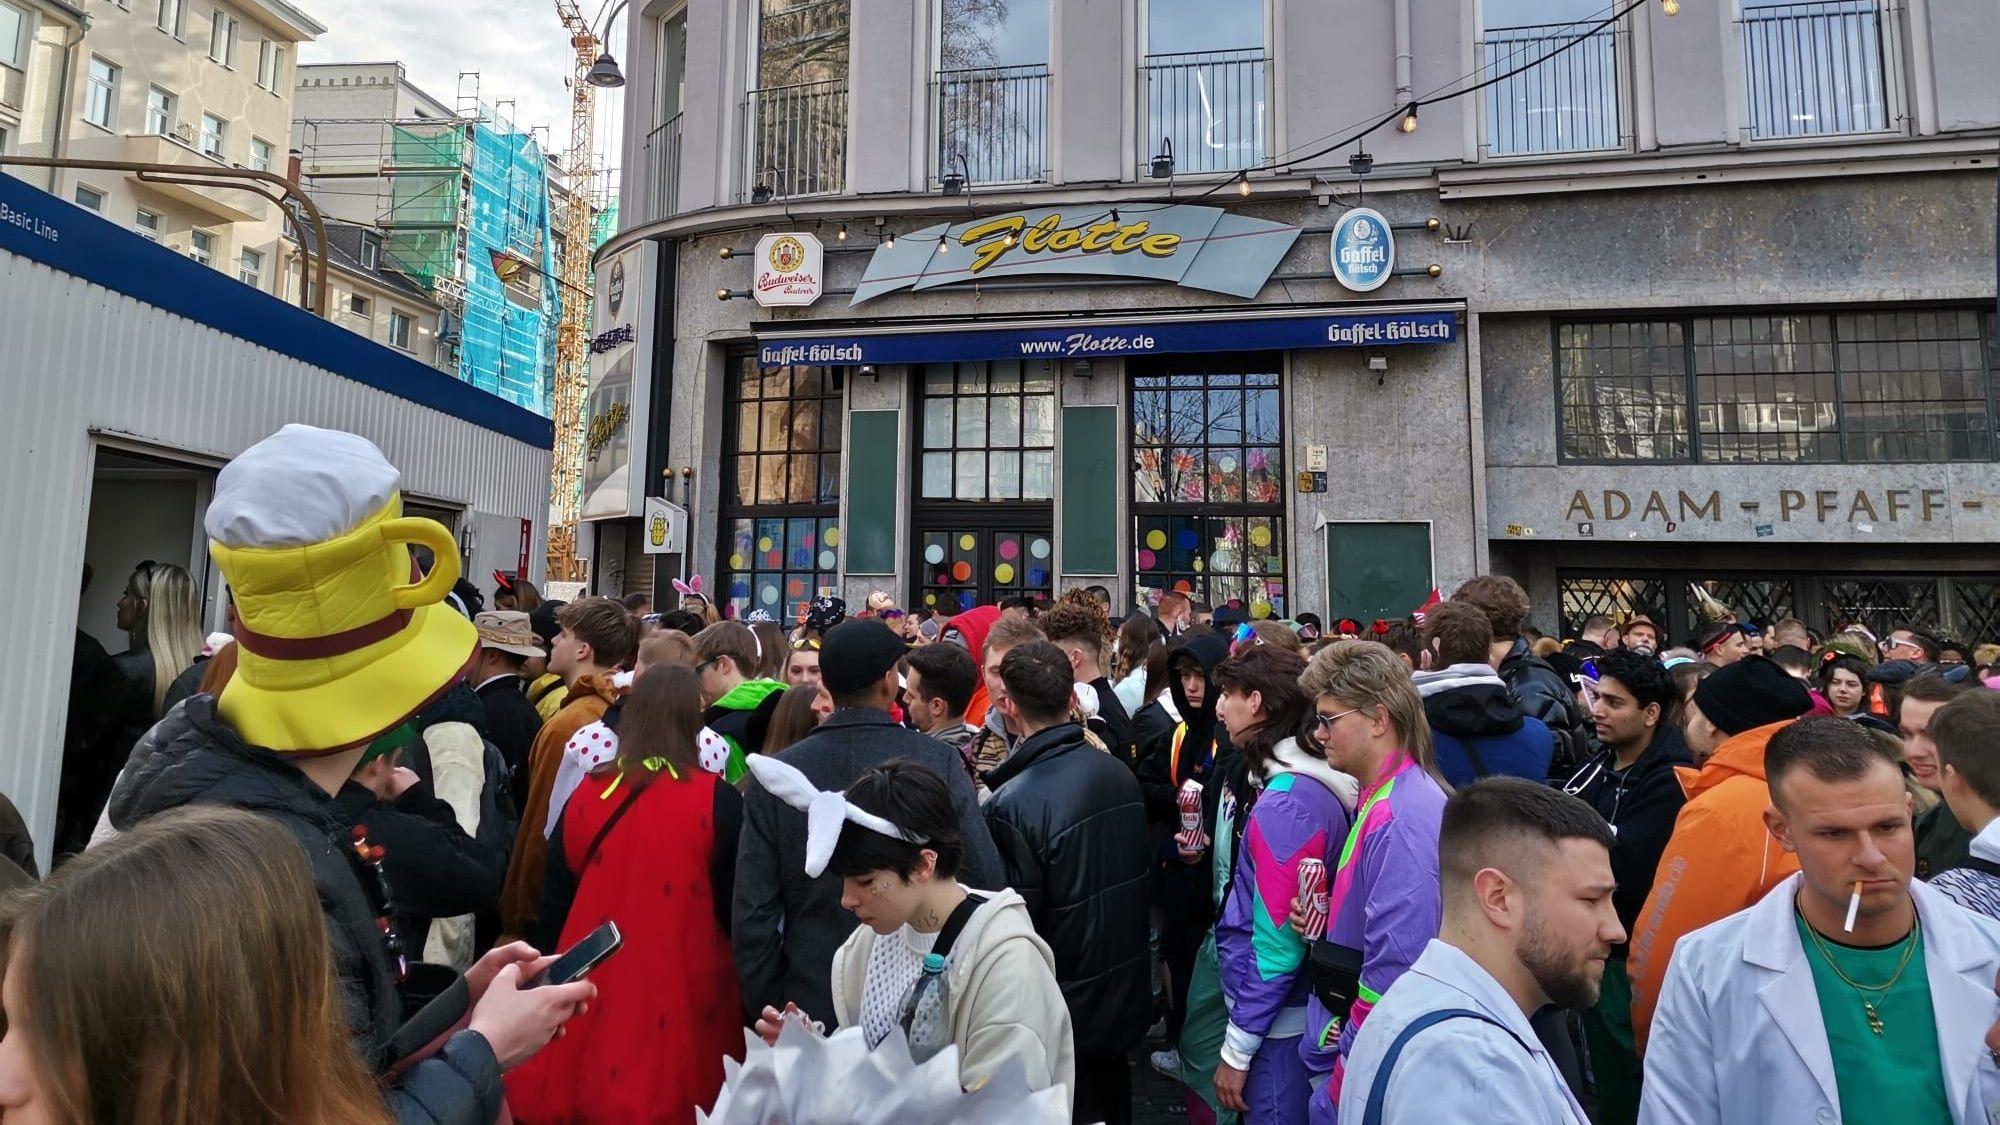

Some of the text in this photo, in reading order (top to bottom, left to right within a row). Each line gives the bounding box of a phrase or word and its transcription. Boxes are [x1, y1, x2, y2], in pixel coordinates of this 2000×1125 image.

[1, 202, 59, 242] Basic Line
[959, 213, 1182, 273] Flotte
[1340, 246, 1386, 264] Gaffel
[757, 272, 815, 291] Budweiser
[1328, 320, 1450, 343] Gaffel-Kölsch
[761, 342, 863, 365] Gaffel-Kölsch
[1021, 334, 1155, 355] www.Flotte.de
[1566, 489, 1721, 522] ADAM
[1780, 489, 1948, 522] PFAFF
